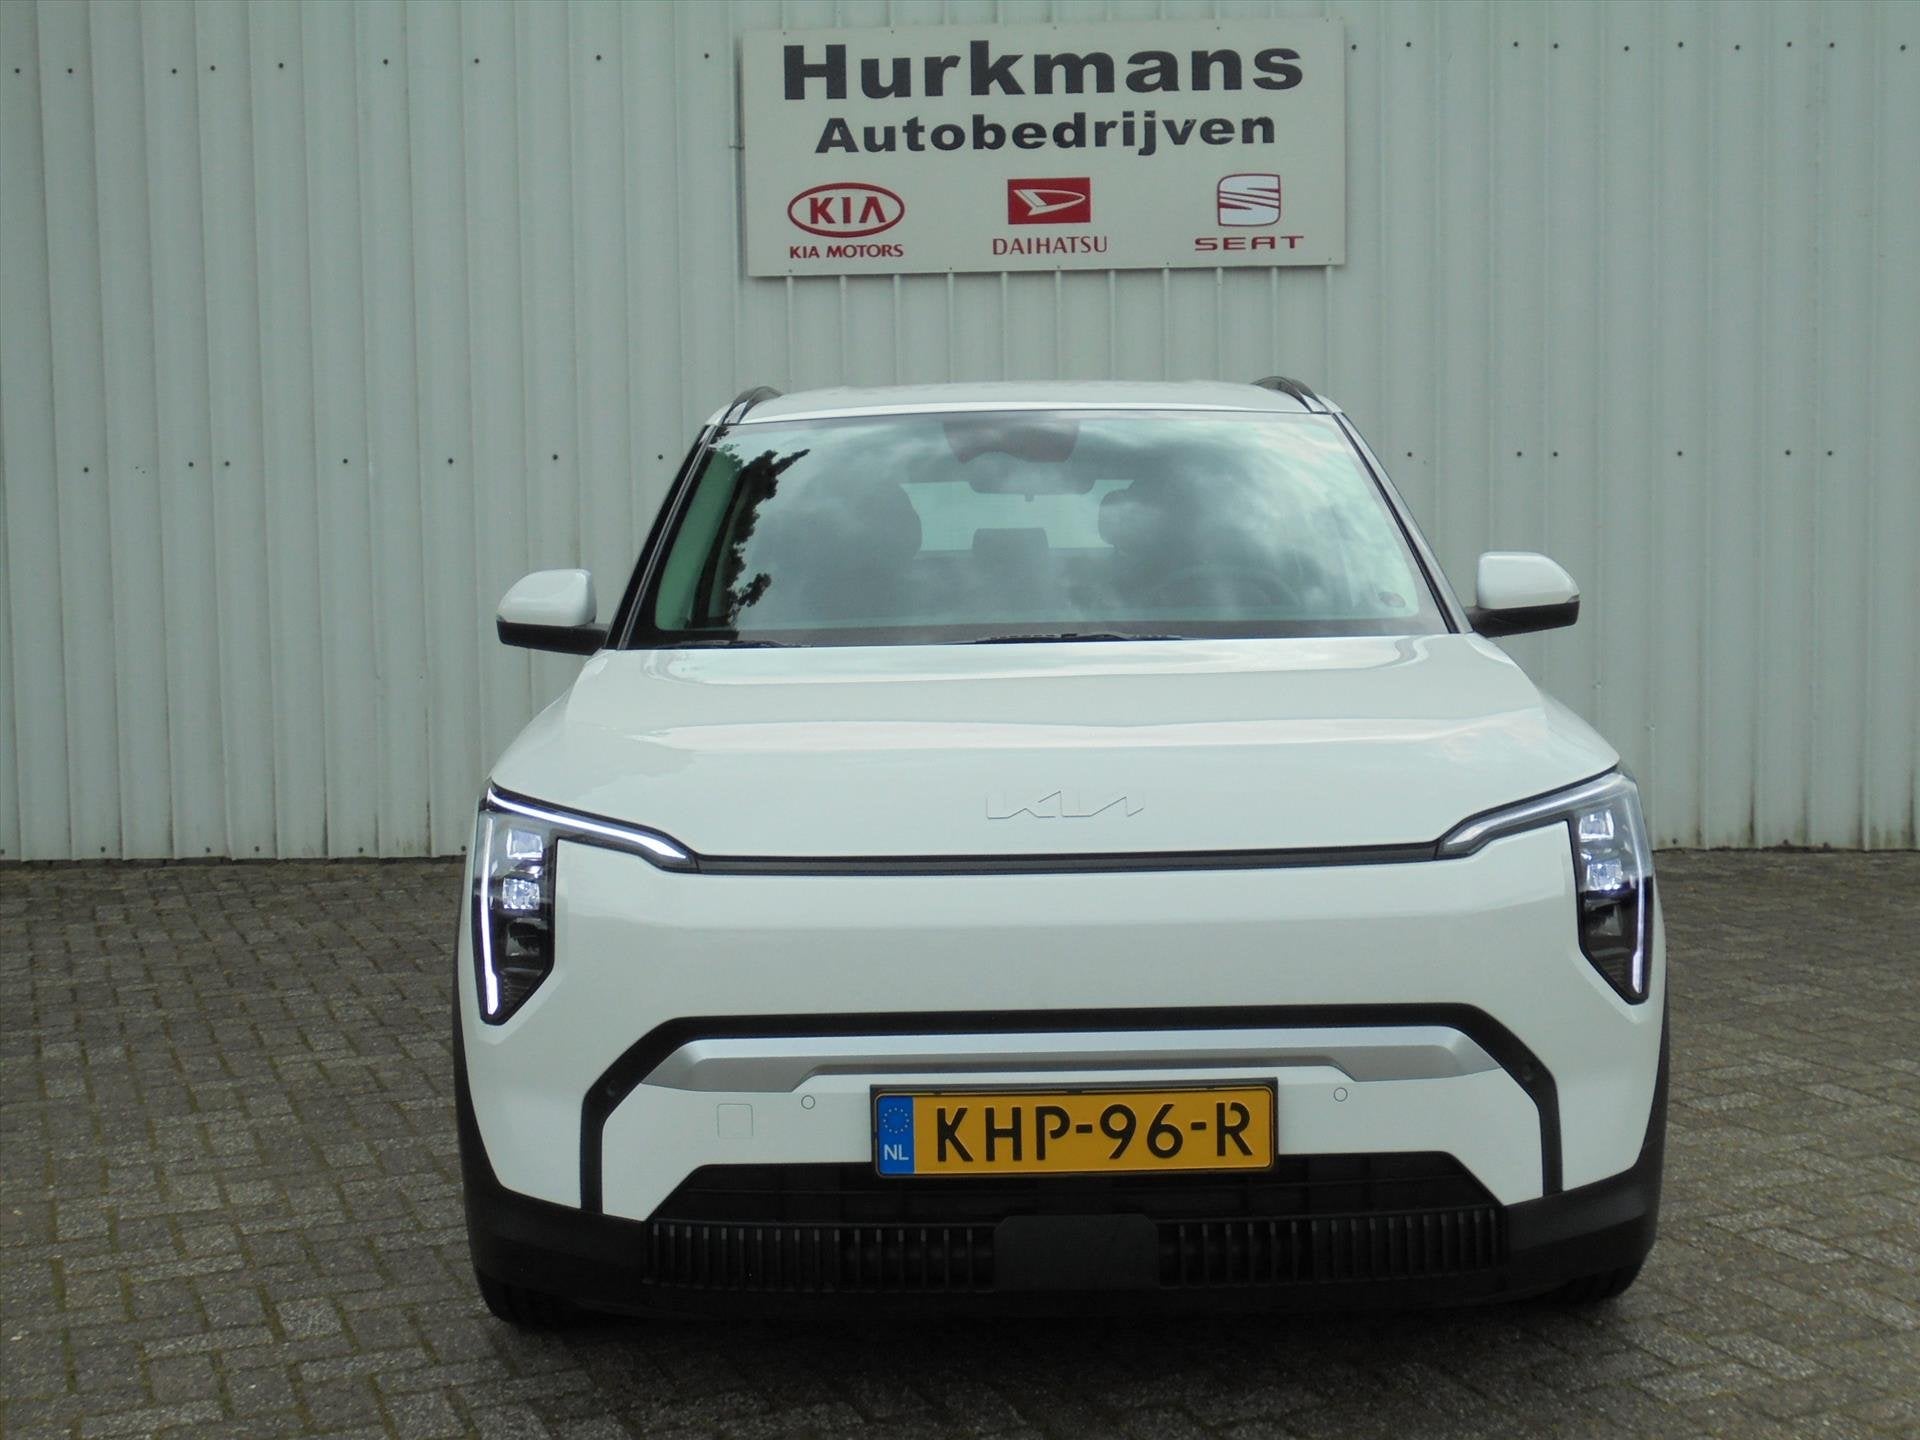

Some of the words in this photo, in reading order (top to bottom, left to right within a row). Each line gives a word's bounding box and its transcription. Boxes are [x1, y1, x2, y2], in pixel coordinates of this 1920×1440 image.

[783, 40, 1303, 100] Hurkmans
[814, 111, 1276, 156] Autobedrijven
[809, 196, 887, 225] KIA
[789, 246, 821, 259] KIA
[826, 244, 904, 258] MOTORS
[992, 236, 1108, 256] DAIHATSU
[1194, 236, 1304, 251] SEAT
[937, 1102, 1253, 1162] KHP-96-R
[884, 1144, 909, 1161] NL
